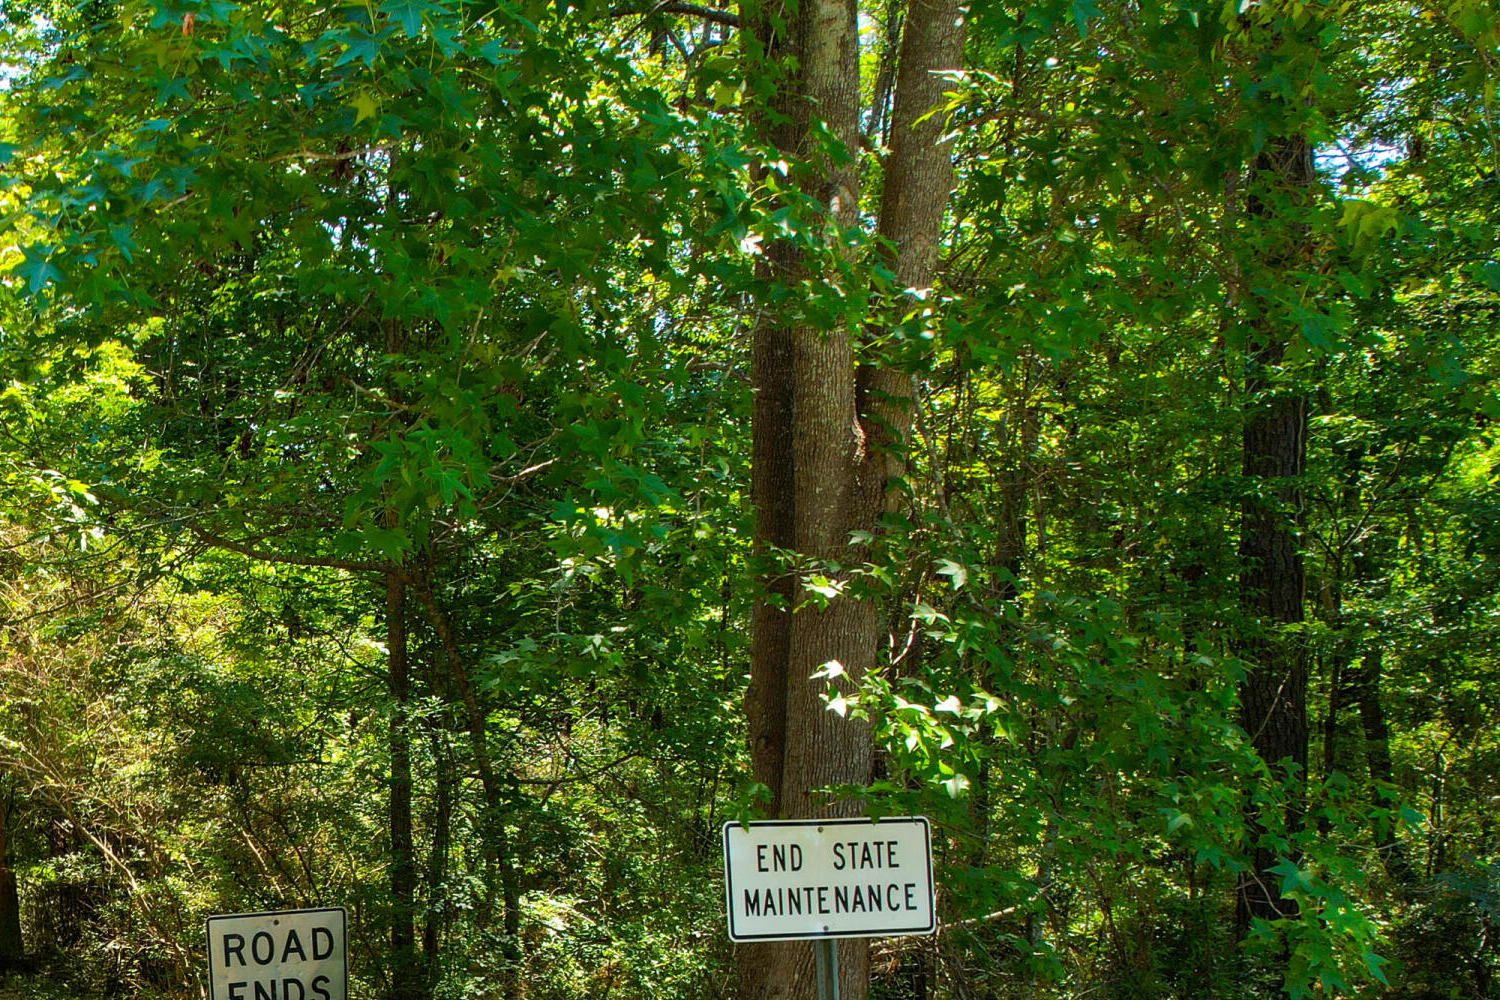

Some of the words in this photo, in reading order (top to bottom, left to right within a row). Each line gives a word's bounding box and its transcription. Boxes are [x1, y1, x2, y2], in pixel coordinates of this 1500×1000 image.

[757, 844, 802, 873] END
[833, 841, 900, 870] STATE
[744, 883, 917, 917] MAINTENANCE
[223, 927, 334, 967] ROAD
